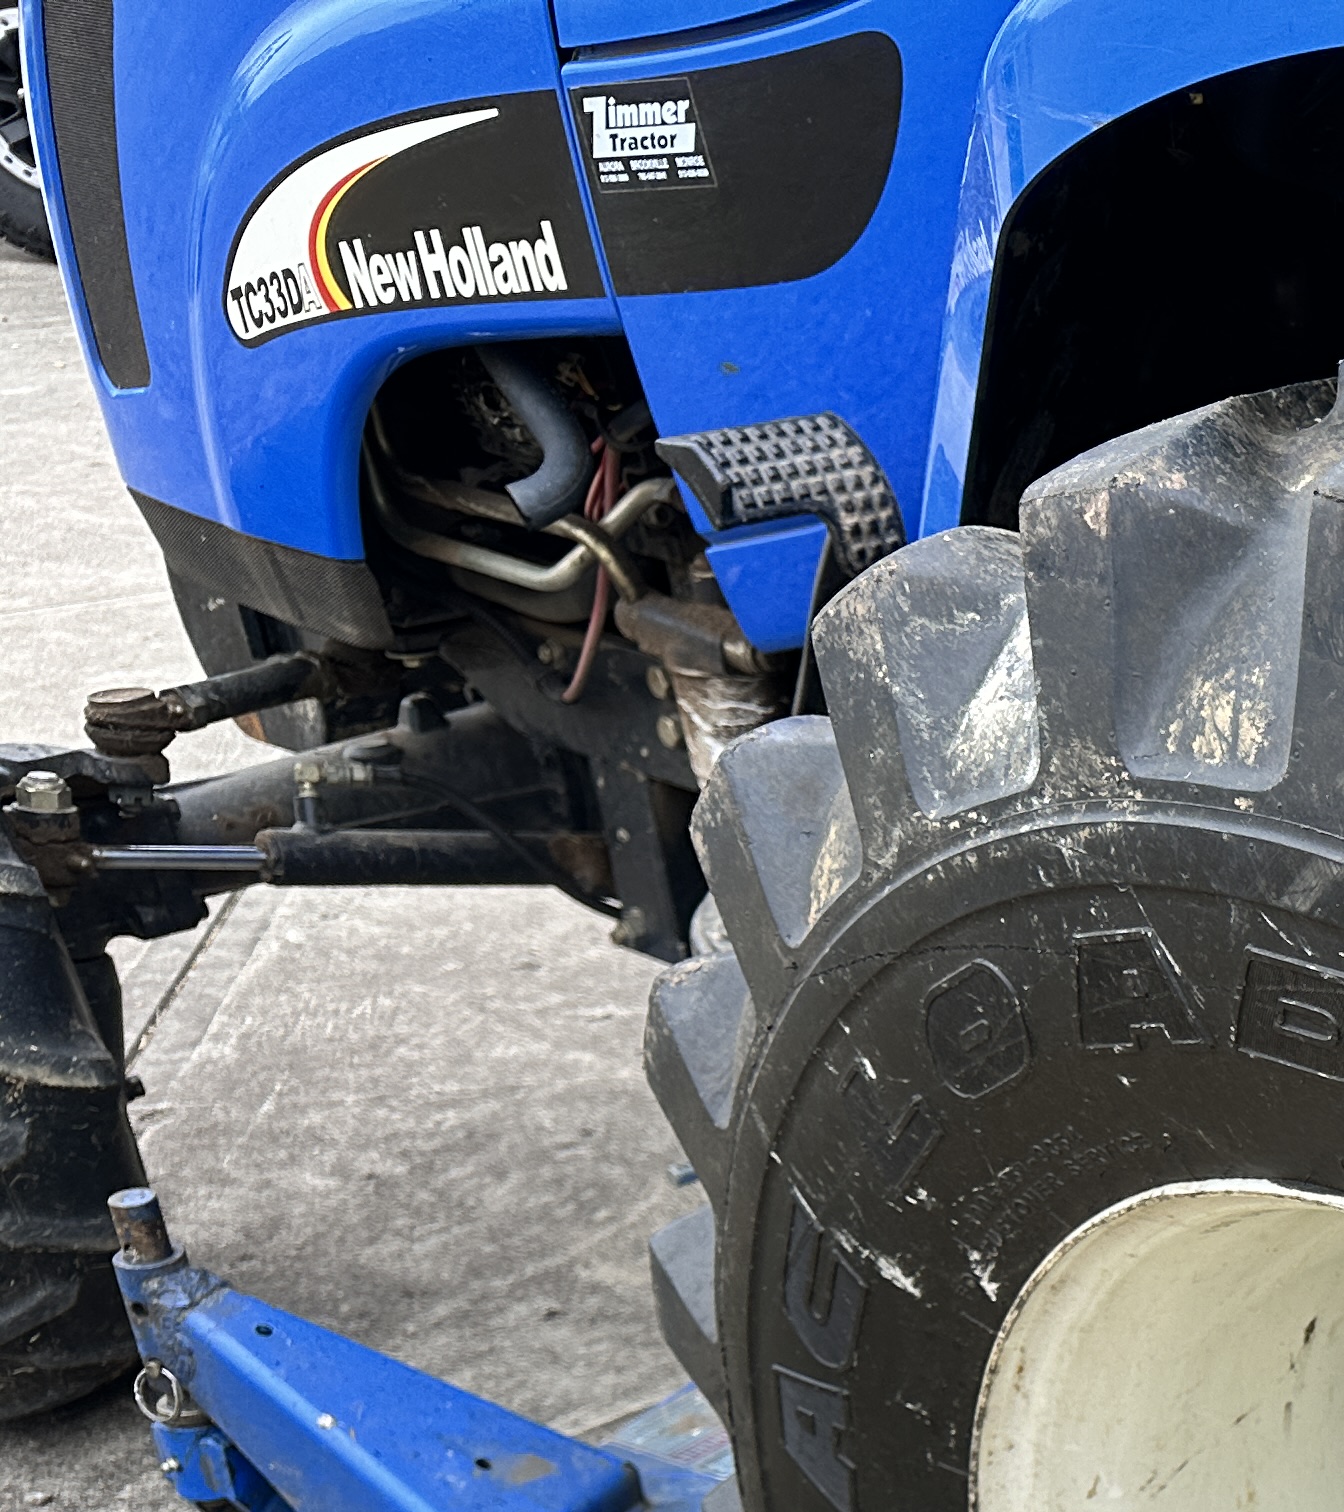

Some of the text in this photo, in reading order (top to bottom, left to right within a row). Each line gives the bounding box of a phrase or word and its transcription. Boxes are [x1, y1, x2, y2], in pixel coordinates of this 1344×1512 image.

[583, 96, 691, 141] Zimmer
[609, 132, 677, 152] Tractor
[338, 219, 568, 310] New Holland
[230, 262, 323, 334] TC33DA
